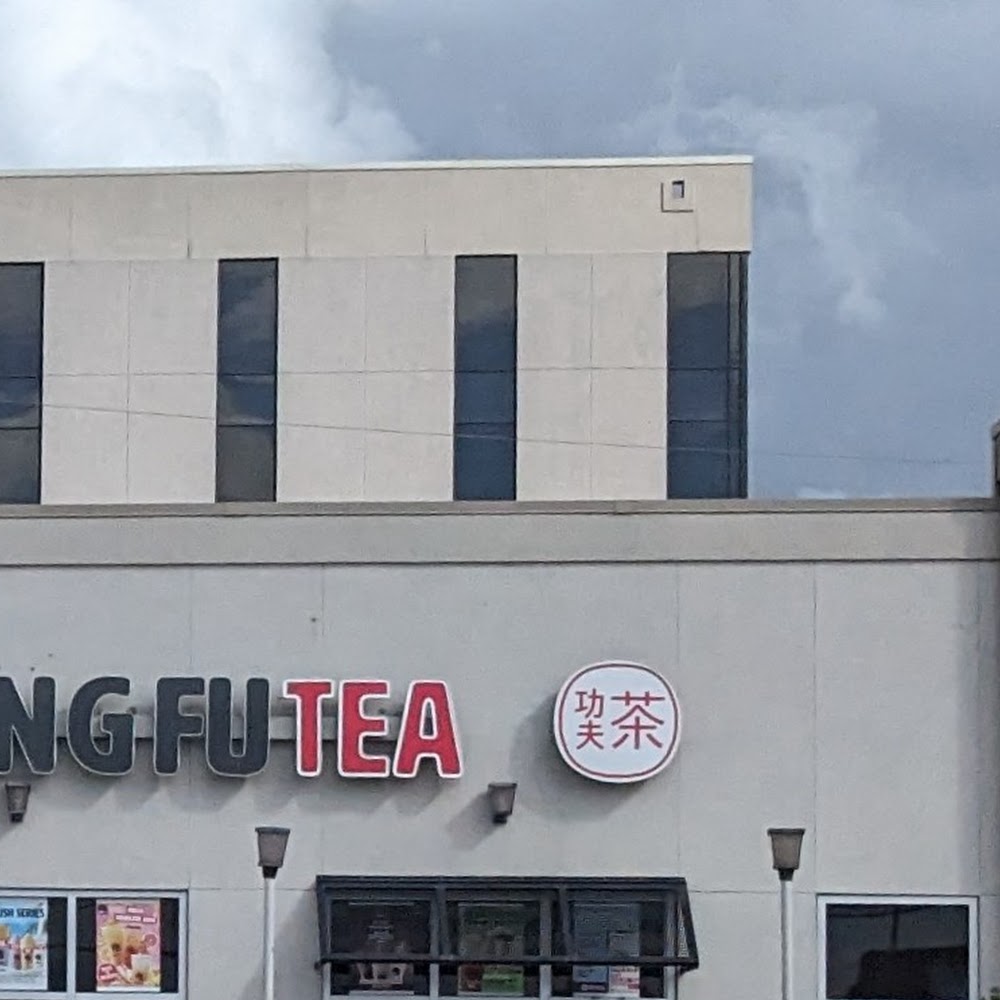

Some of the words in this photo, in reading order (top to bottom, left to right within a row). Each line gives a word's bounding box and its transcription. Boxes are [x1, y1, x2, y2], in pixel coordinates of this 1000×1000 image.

[152, 675, 271, 777] FU
[282, 679, 463, 778] TEA
[574, 688, 605, 750] 功夫
[611, 690, 666, 750] 茶
